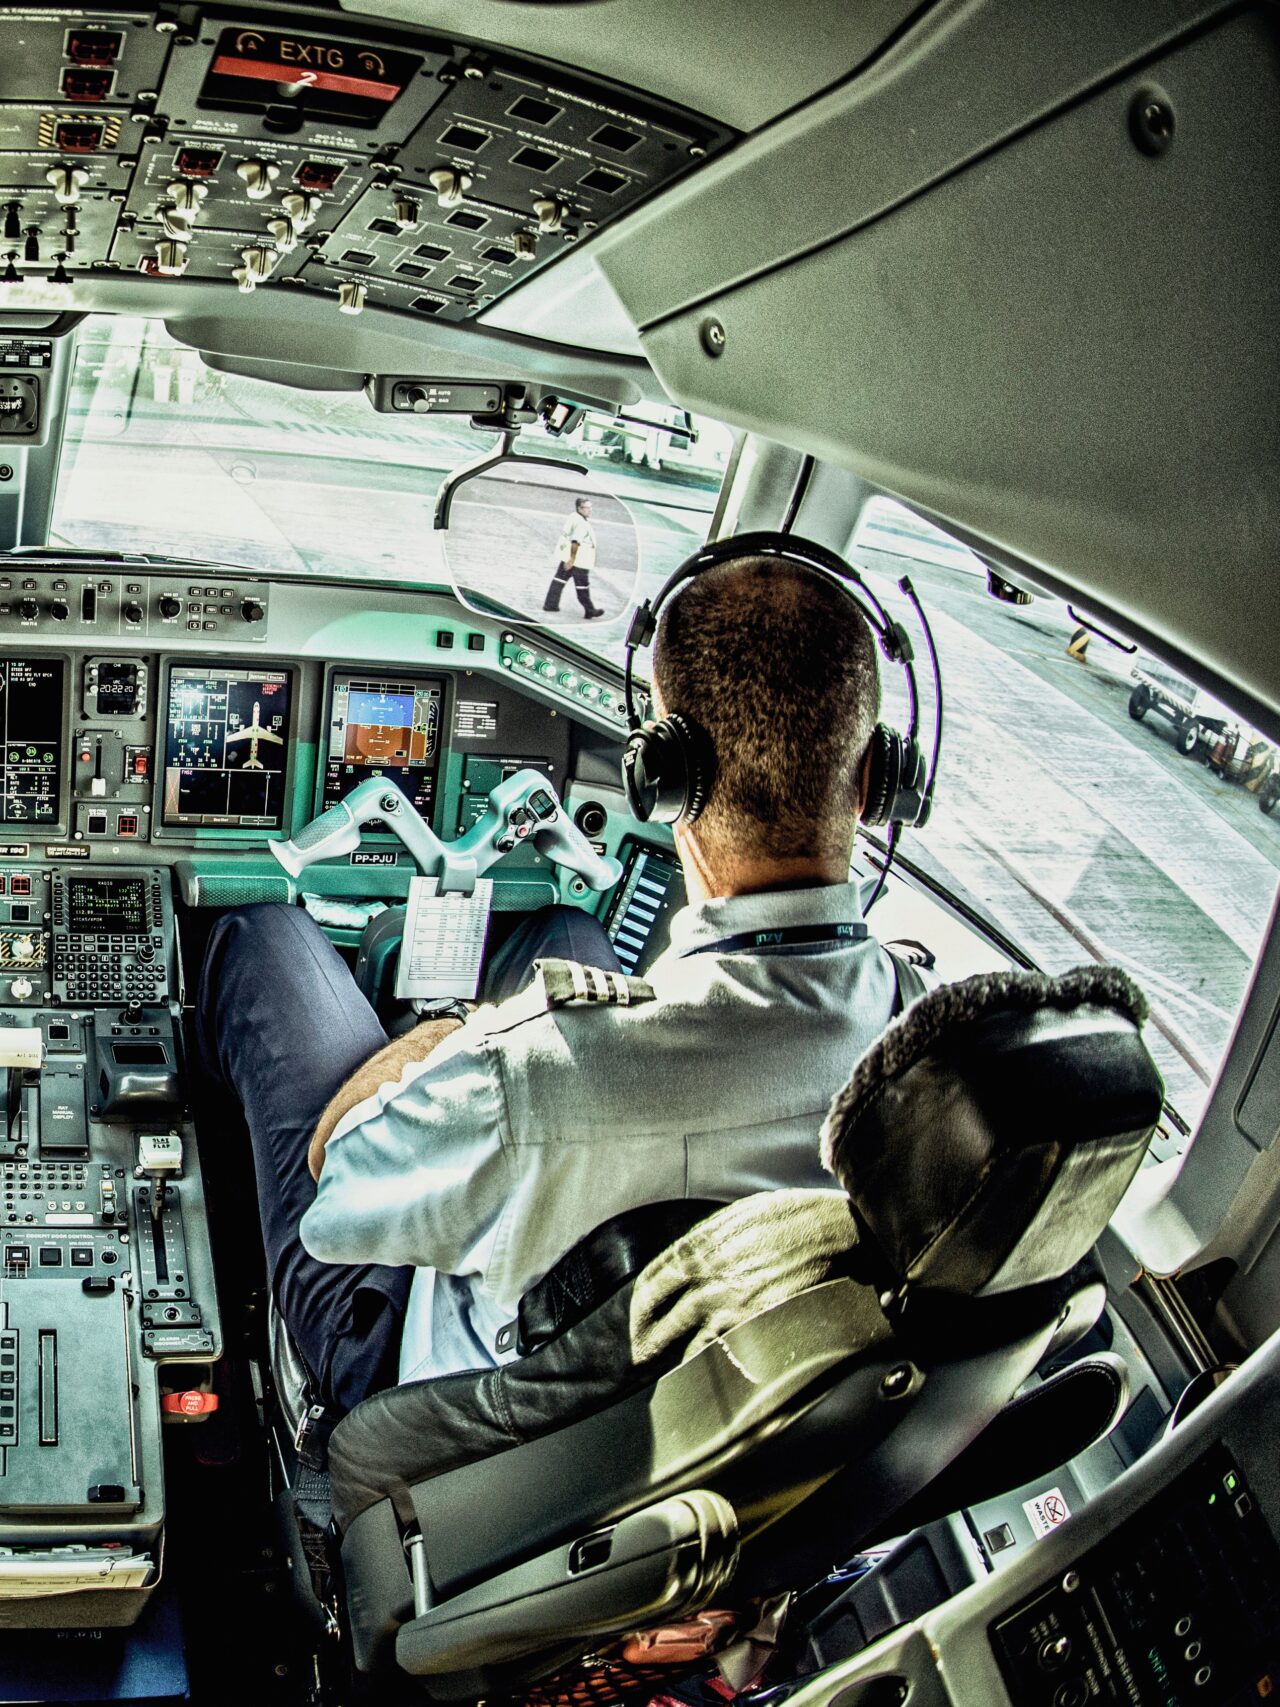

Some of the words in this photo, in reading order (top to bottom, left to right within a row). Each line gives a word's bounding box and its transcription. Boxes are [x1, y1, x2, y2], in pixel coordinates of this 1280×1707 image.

[279, 41, 344, 69] EXTG
[298, 70, 319, 88] 2
[355, 854, 393, 863] PP-PJU
[756, 932, 783, 945] Azul
[1034, 1502, 1051, 1530] WASTE
